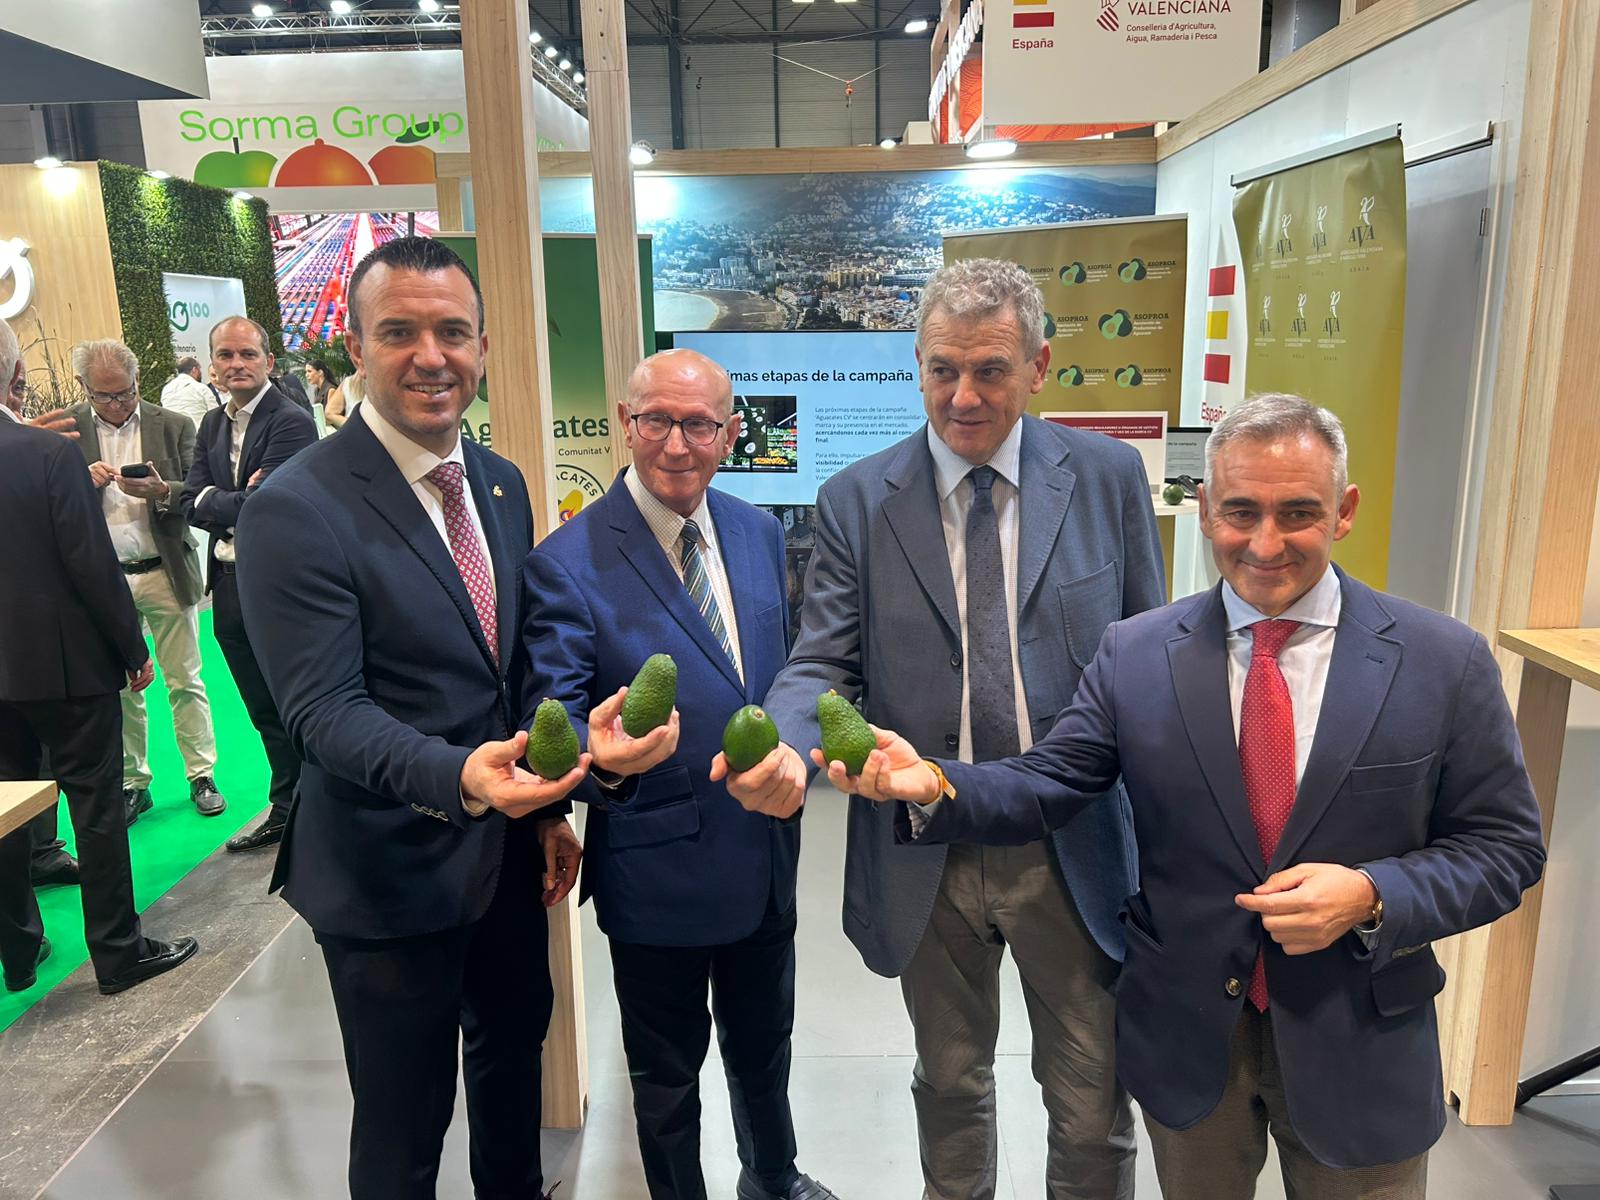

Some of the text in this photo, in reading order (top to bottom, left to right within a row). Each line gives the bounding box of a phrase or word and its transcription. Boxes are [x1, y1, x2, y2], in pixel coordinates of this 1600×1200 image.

[1127, 0, 1232, 15] VALENCIANA
[1126, 22, 1217, 32] Conselleria d'Agricultura,
[1012, 38, 1054, 50] España
[1126, 34, 1149, 44] Aigua,
[1150, 33, 1190, 42] Ramaderia
[1195, 32, 1218, 40] Pesca
[179, 106, 465, 144] Sorma Group
[1348, 225, 1375, 247] AVA
[1276, 239, 1292, 258] AVA
[1291, 318, 1307, 336] AVA
[1323, 318, 1340, 337] AVA
[726, 369, 913, 384] imas etapas de la campaña
[558, 447, 603, 456] Comunitat
